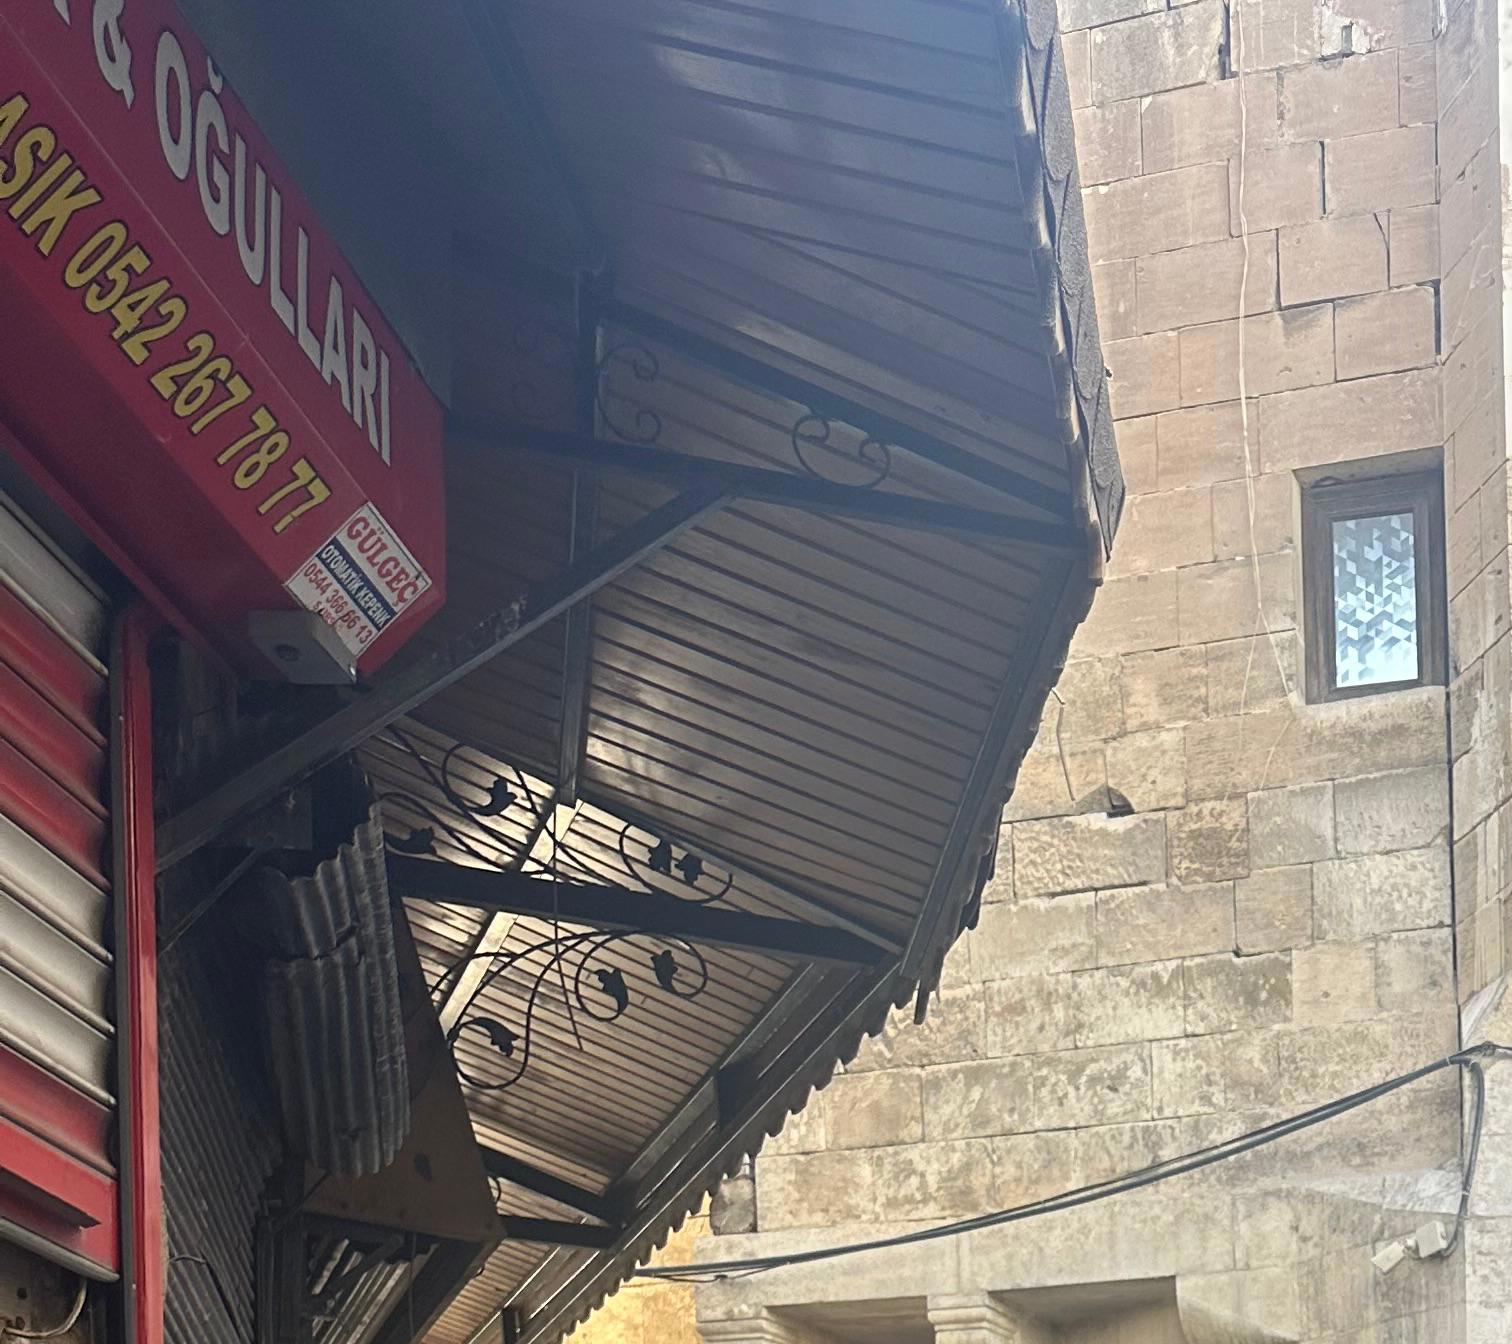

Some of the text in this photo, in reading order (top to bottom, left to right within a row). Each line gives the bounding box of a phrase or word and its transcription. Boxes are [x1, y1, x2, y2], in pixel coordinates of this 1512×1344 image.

[154, 31, 391, 467] OĞULLARI
[63, 219, 188, 366] 0542
[149, 331, 253, 436] 267
[215, 405, 291, 490] 78
[257, 457, 333, 536] 77
[303, 563, 333, 596] 0544
[326, 589, 348, 613] 366
[355, 624, 373, 644] 13
[321, 545, 364, 594] OTOMATİK
[354, 582, 391, 628] KEPENK
[346, 515, 419, 607] GÜLGEÇ
